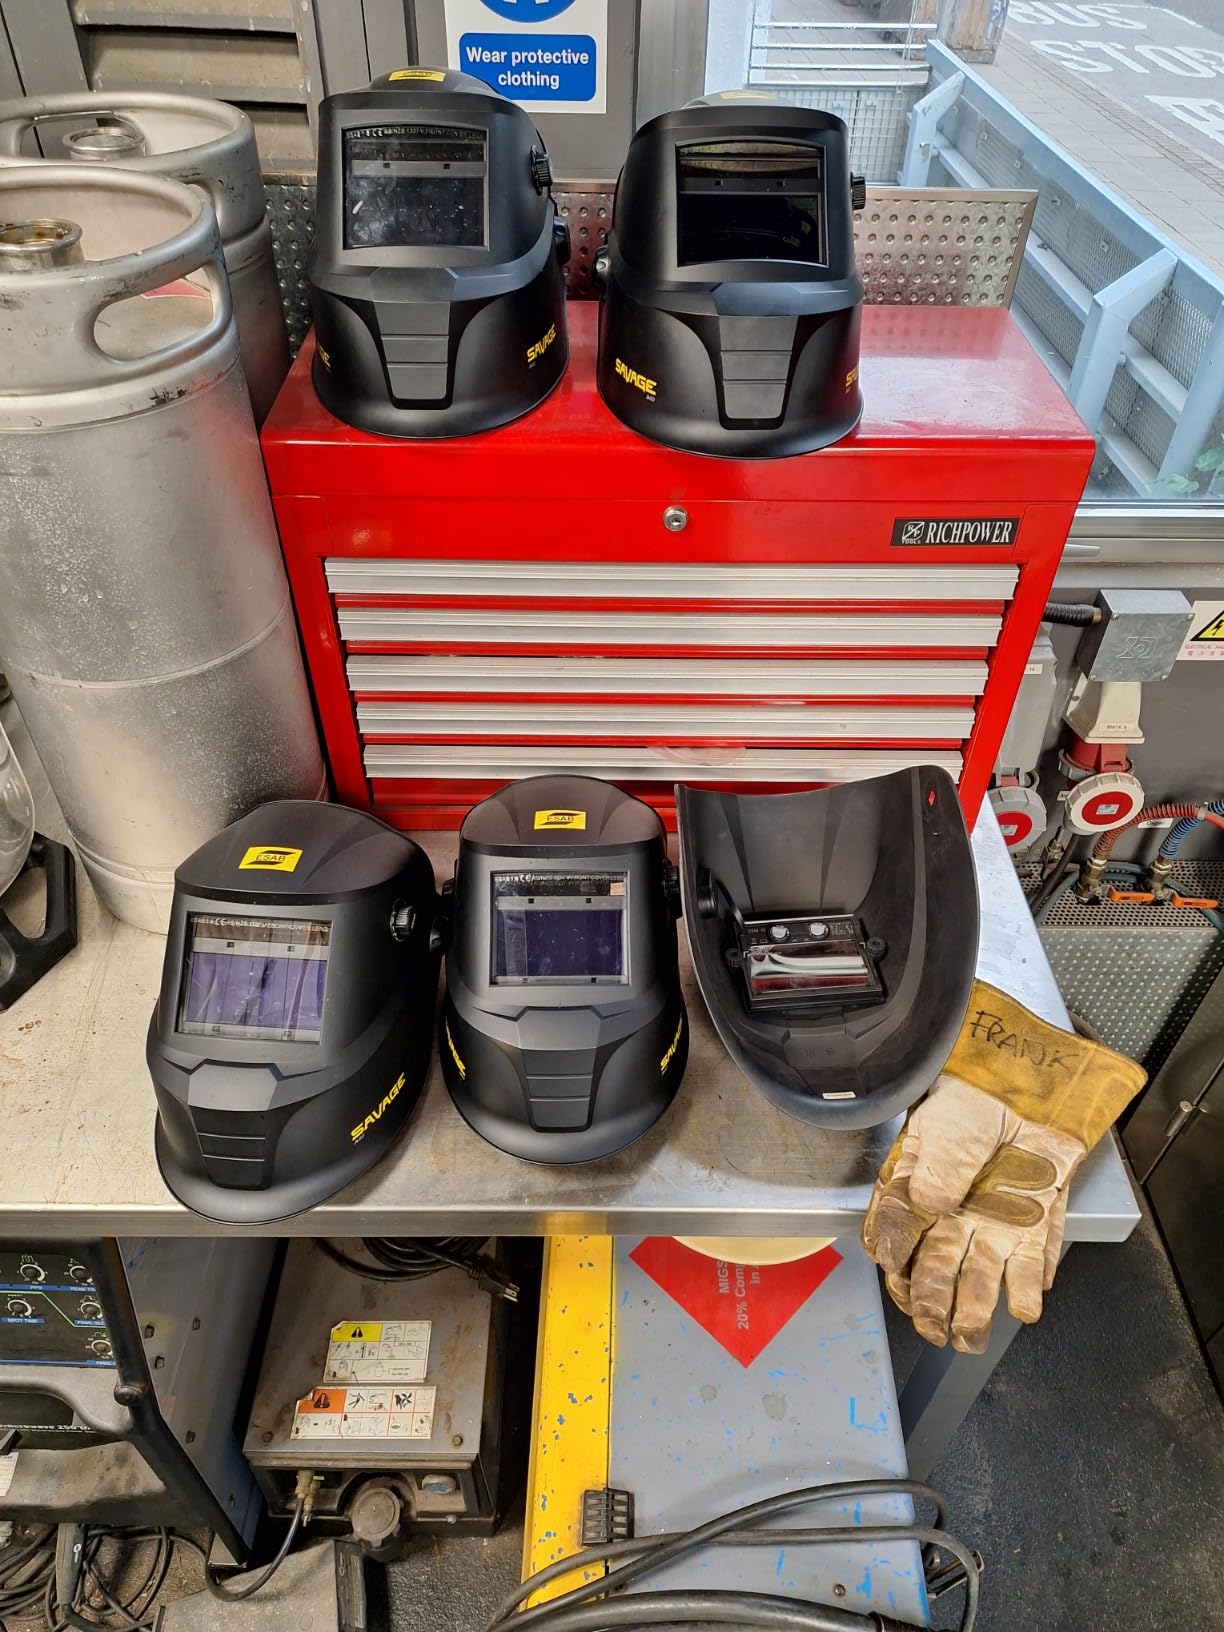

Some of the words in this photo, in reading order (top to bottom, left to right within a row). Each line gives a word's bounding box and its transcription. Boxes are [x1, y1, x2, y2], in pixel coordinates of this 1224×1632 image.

[1007, 0, 1147, 30] BUS
[466, 46, 506, 64] Wear
[511, 48, 589, 66] protective
[498, 71, 560, 90] clothing
[526, 323, 556, 363] SAVAGE
[615, 358, 657, 396] SAVAGE
[925, 522, 1013, 543] RICHPOWER
[255, 854, 287, 862] ESAB
[970, 1011, 1080, 1072] FRANK
[351, 1072, 406, 1141] SAVAGE
[736, 1301, 749, 1330] 20%
